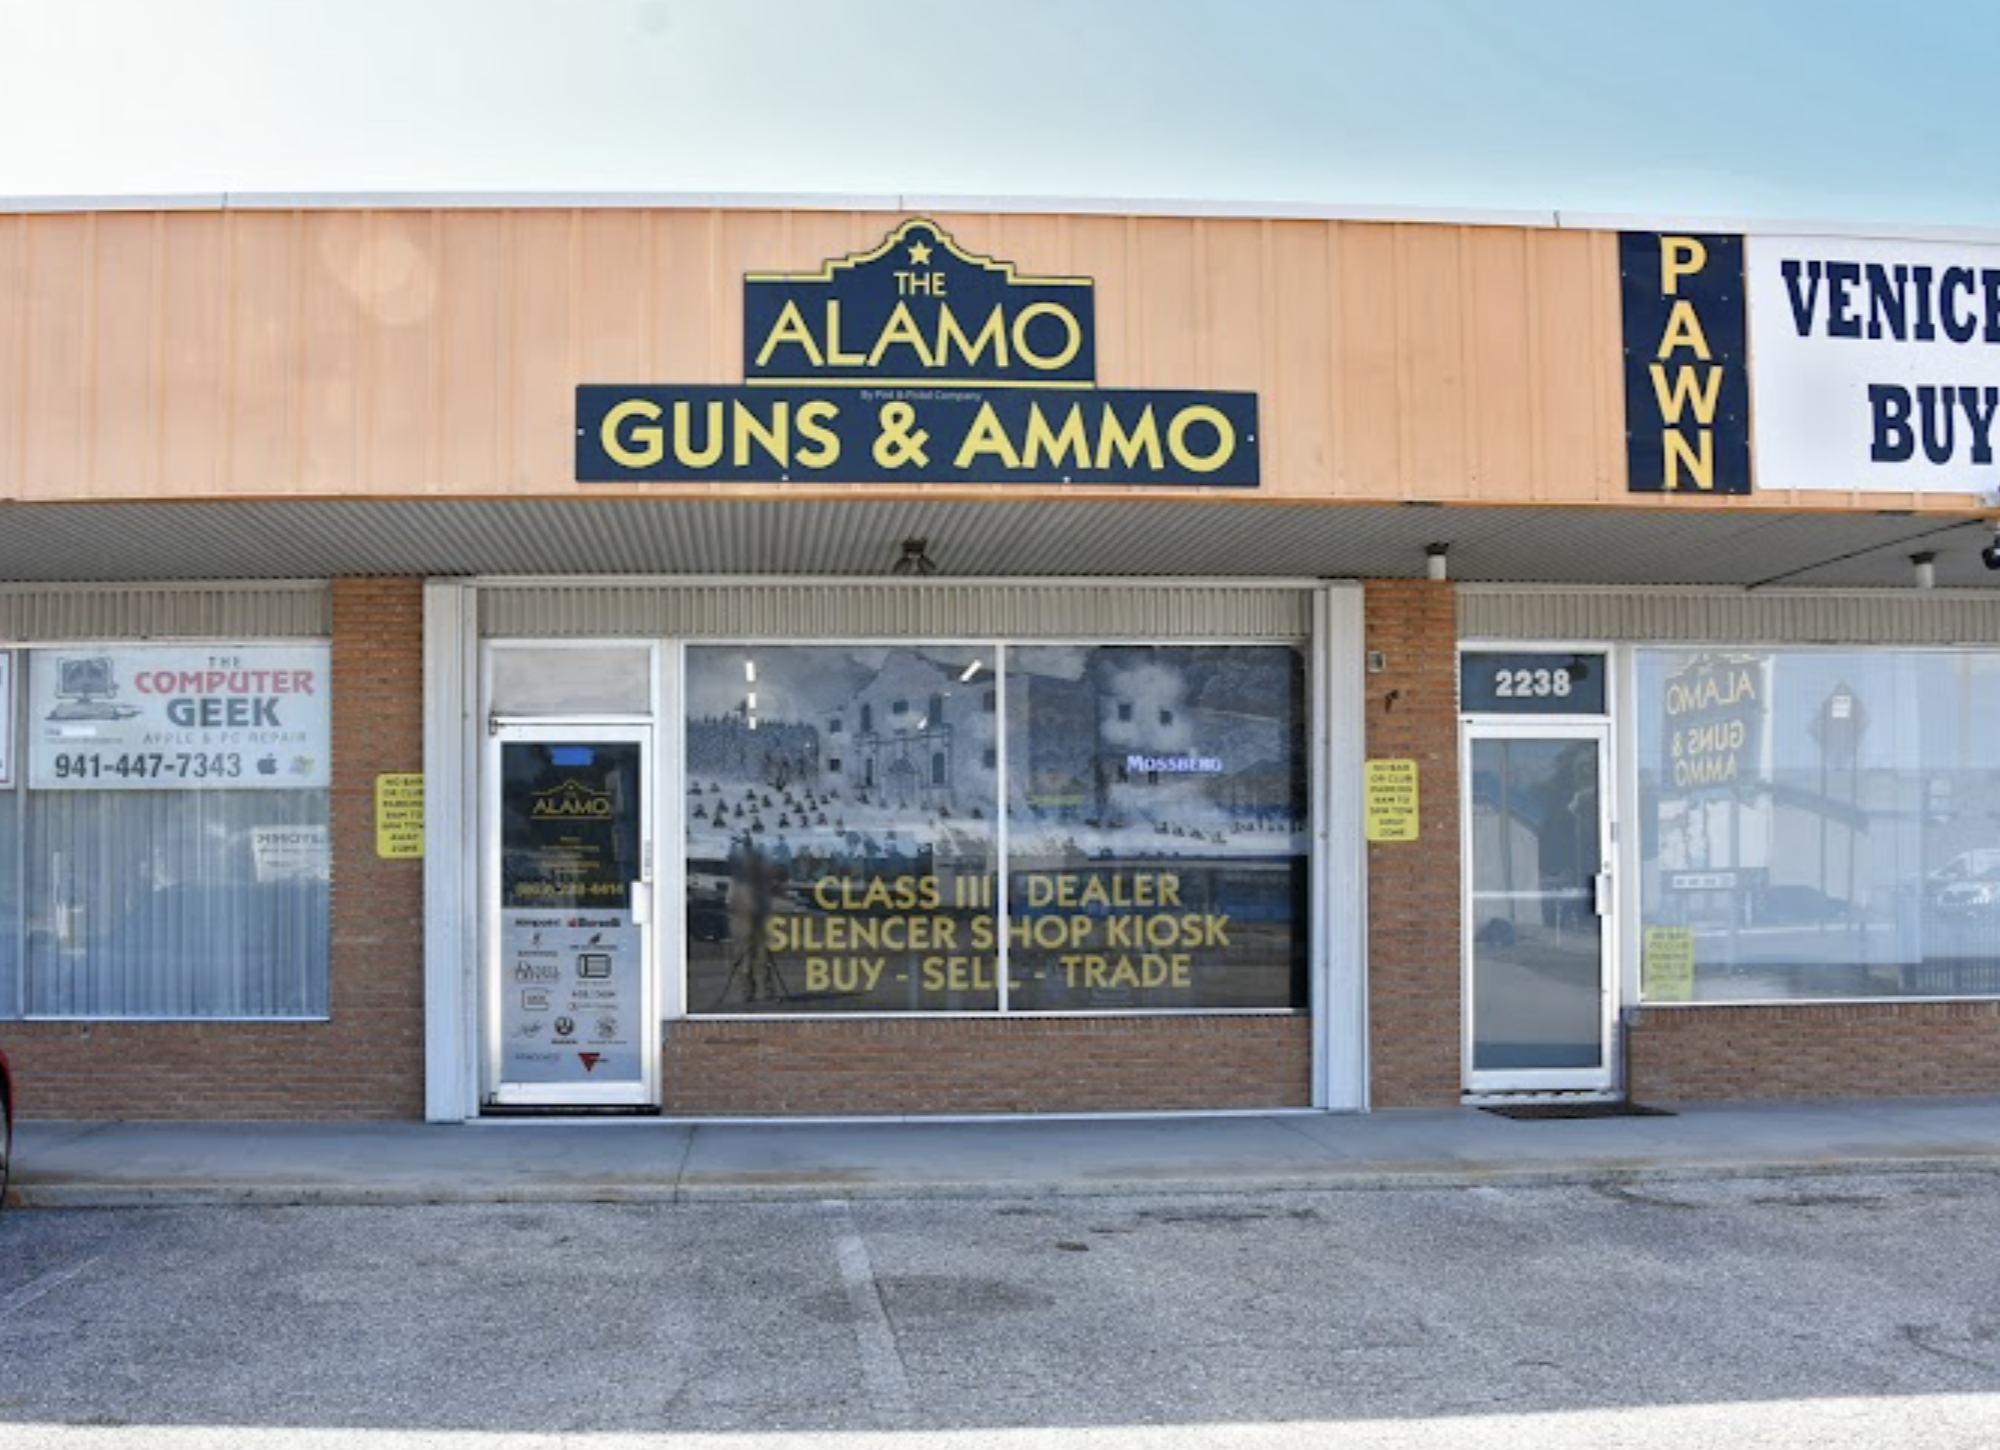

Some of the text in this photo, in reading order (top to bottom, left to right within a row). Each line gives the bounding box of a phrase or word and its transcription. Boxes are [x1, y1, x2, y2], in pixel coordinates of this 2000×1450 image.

[894, 271, 947, 297] THE
[754, 299, 1082, 371] ALAMO
[1649, 236, 1724, 490] PAWN
[935, 389, 981, 403] Company
[599, 399, 1236, 473] GUNS & AMMO
[1867, 383, 2000, 466] BUY
[208, 656, 243, 669] THE
[134, 670, 315, 696] COMPUTER
[1495, 668, 1571, 697] 2238
[166, 697, 282, 727] GEEK
[143, 731, 195, 745] APPLE
[220, 731, 241, 745] PC
[248, 731, 308, 745] REPAIR
[54, 753, 241, 778] 941-447-7343
[532, 797, 611, 815] ALAMO
[814, 875, 941, 910] CLASS
[1027, 873, 1183, 908] DEALER
[765, 914, 1230, 951] SILENCER SHOP KIOSK
[805, 956, 886, 992] BUY
[1060, 954, 1192, 989] TRADE
